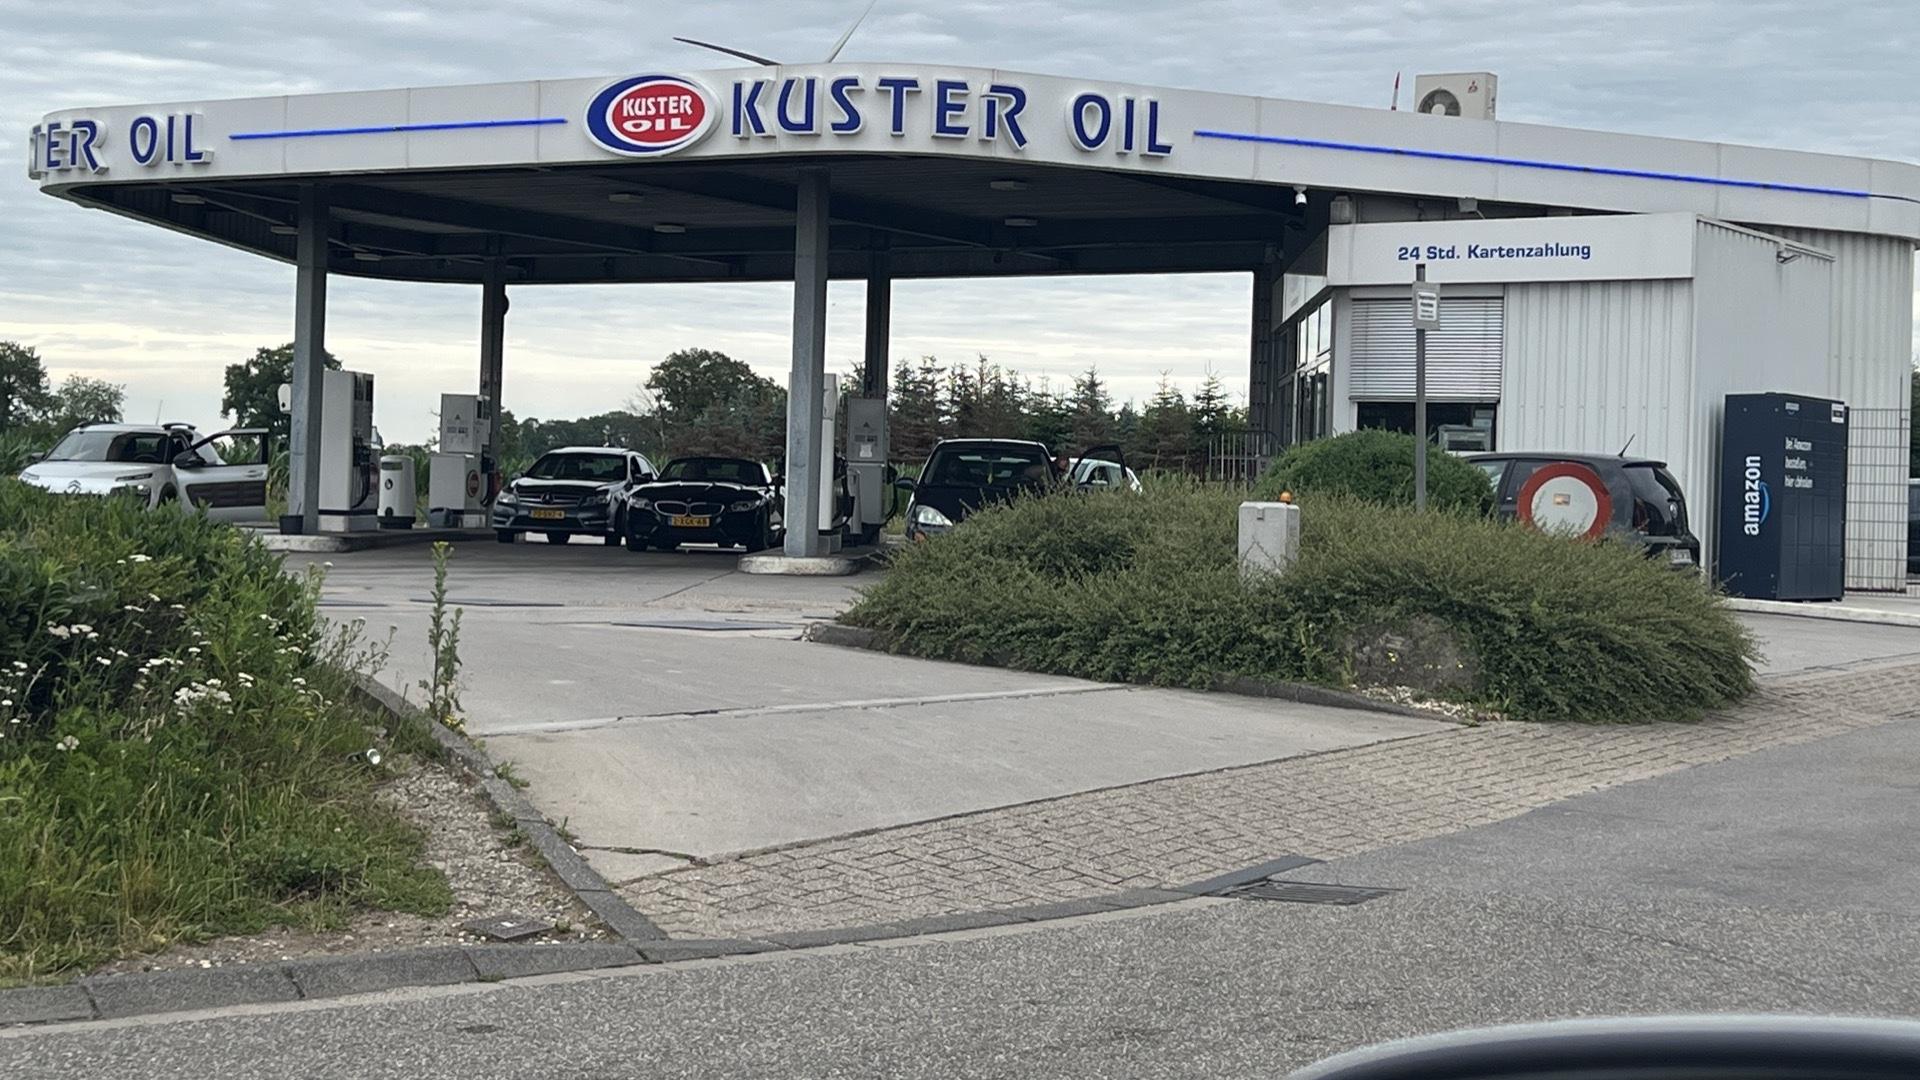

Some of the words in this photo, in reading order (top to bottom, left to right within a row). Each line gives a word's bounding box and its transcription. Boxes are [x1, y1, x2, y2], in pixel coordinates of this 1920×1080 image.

[622, 95, 693, 117] KUSTER
[622, 117, 692, 133] OIL
[732, 77, 1029, 149] KUSTER
[1068, 92, 1175, 155] OIL
[129, 113, 208, 167] OIL
[1398, 246, 1421, 261] 24
[1426, 245, 1461, 260] Std.
[1467, 242, 1591, 260] Kartenzahlung
[1743, 455, 1761, 536] amazon
